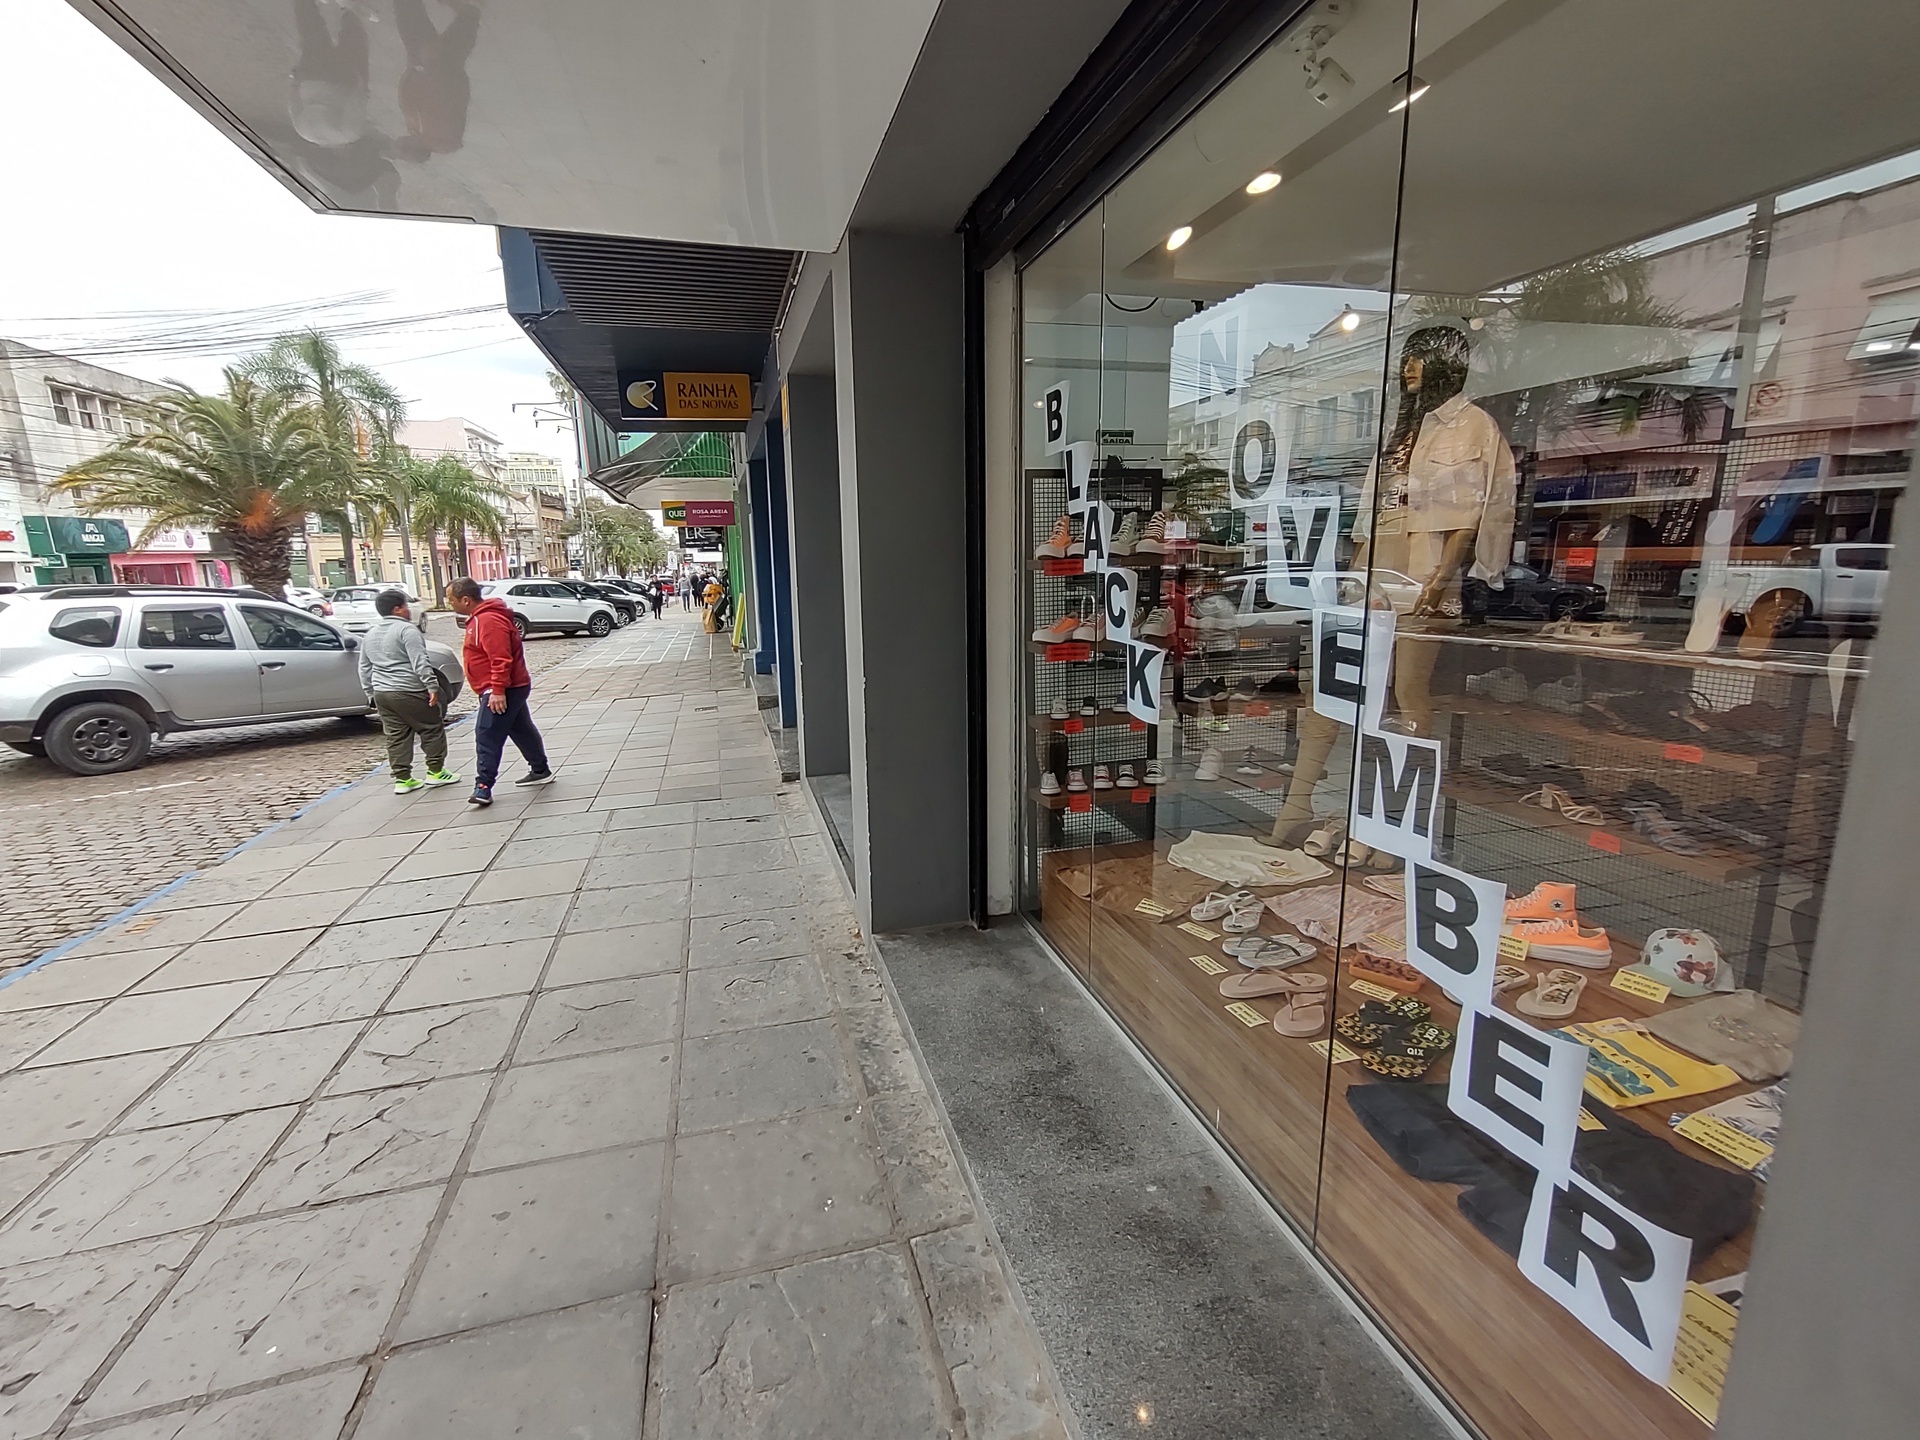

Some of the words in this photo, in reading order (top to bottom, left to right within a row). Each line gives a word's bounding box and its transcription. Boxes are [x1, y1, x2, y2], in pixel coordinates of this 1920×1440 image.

[677, 382, 738, 398] RAINHA
[679, 399, 699, 409] DAS
[702, 400, 739, 410] NOIVAS
[1045, 388, 1160, 710] BLACK
[1406, 1047, 1424, 1057] QIX
